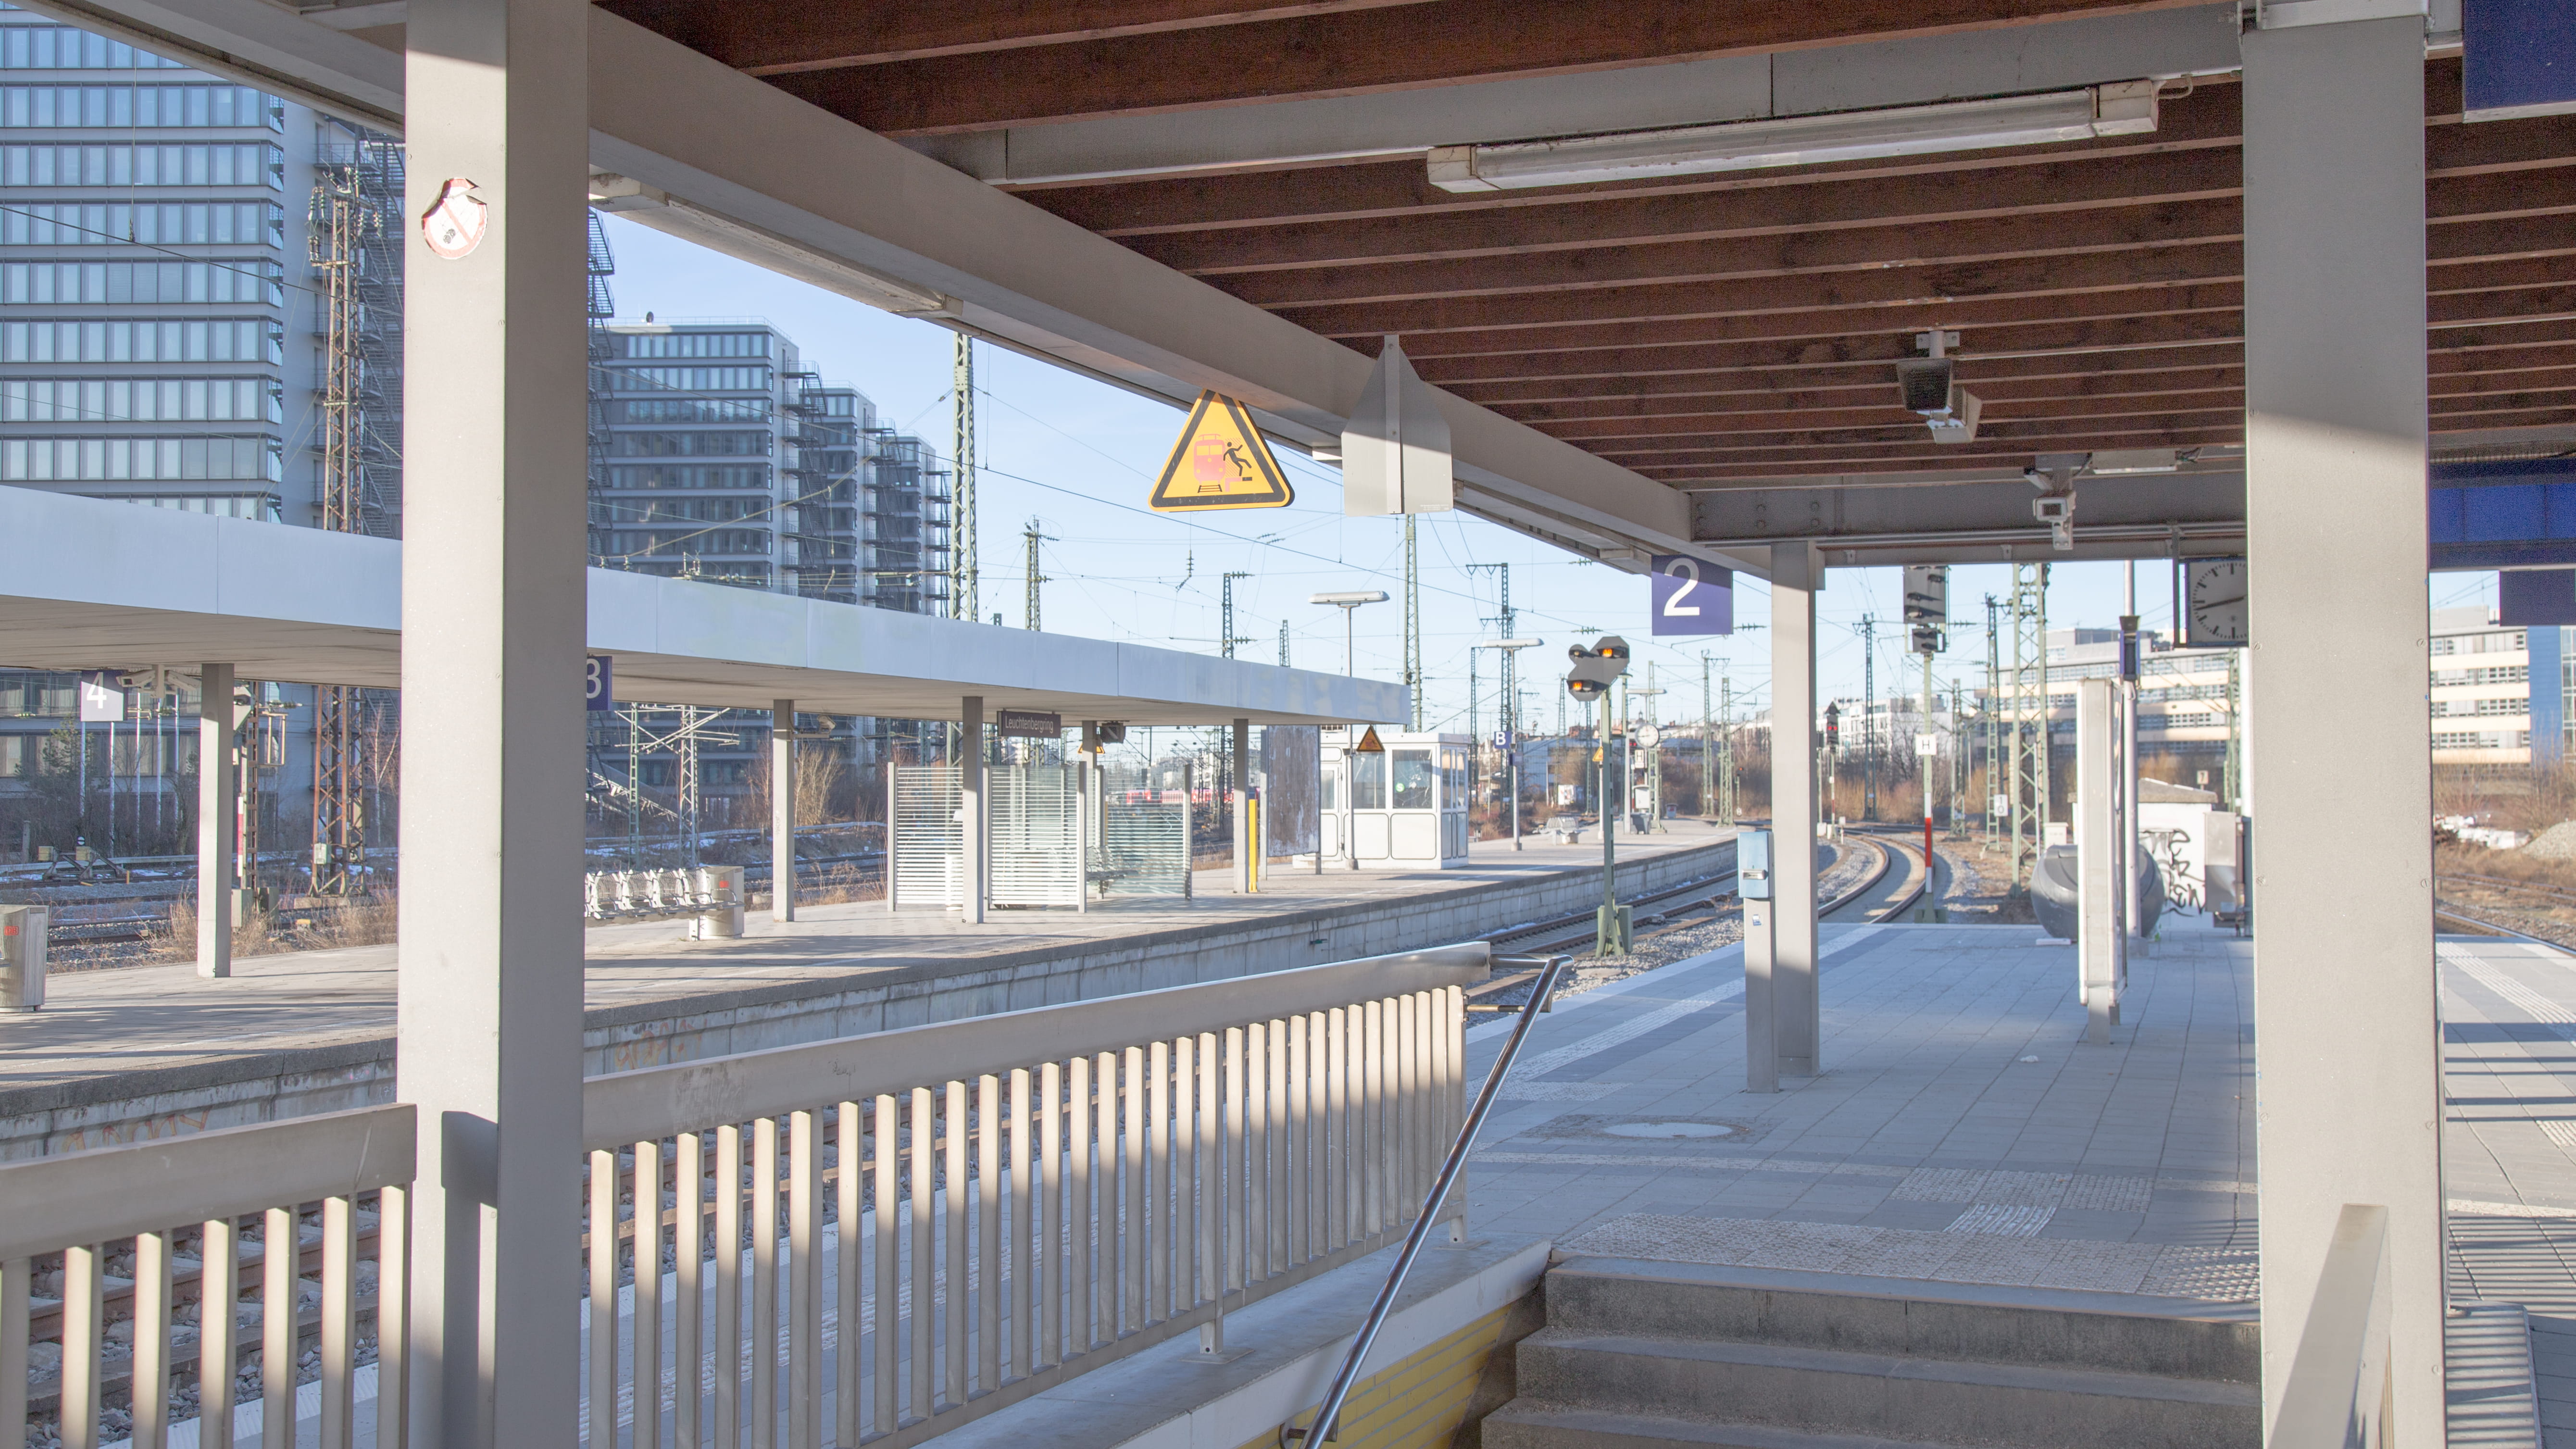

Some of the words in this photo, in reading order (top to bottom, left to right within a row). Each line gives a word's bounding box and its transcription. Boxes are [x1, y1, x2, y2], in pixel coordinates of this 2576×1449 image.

[1664, 558, 1700, 616] 2
[586, 658, 602, 699] 3
[87, 672, 107, 709] 4
[1005, 715, 1053, 734] Leuchtenbergring
[1495, 731, 1506, 746] B
[1922, 739, 1930, 750] H
[1636, 751, 1643, 761] H
[5, 927, 18, 935] DB
